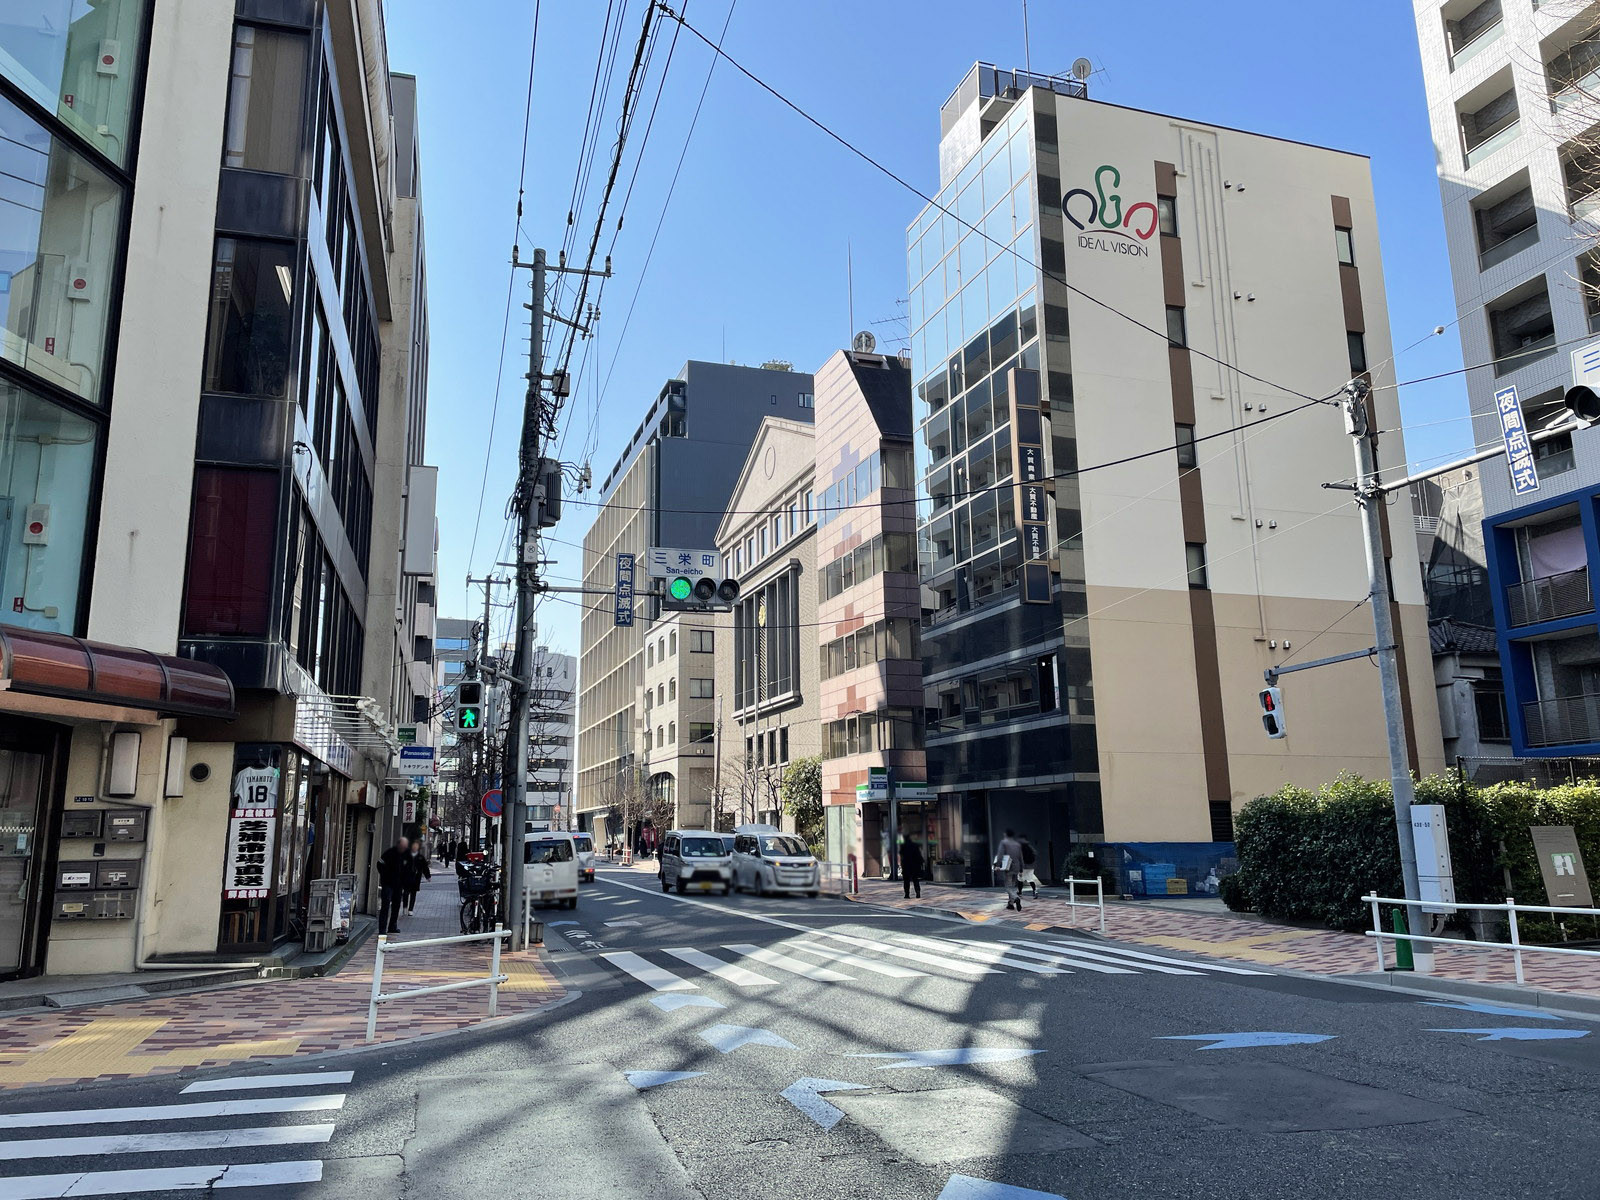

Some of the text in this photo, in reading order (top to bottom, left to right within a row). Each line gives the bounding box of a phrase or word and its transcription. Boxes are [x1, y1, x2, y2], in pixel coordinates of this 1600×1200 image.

[1078, 236, 1149, 258] IDEAL VISION
[1497, 391, 1535, 491] 夜間点滅式
[654, 552, 715, 567] 三栄町
[666, 567, 704, 576] San-eicho
[618, 557, 633, 623] 夜間点滅式
[246, 775, 273, 784] YAMAMOTO
[247, 785, 268, 803] 18
[233, 820, 268, 887] 芝浦市場直送
